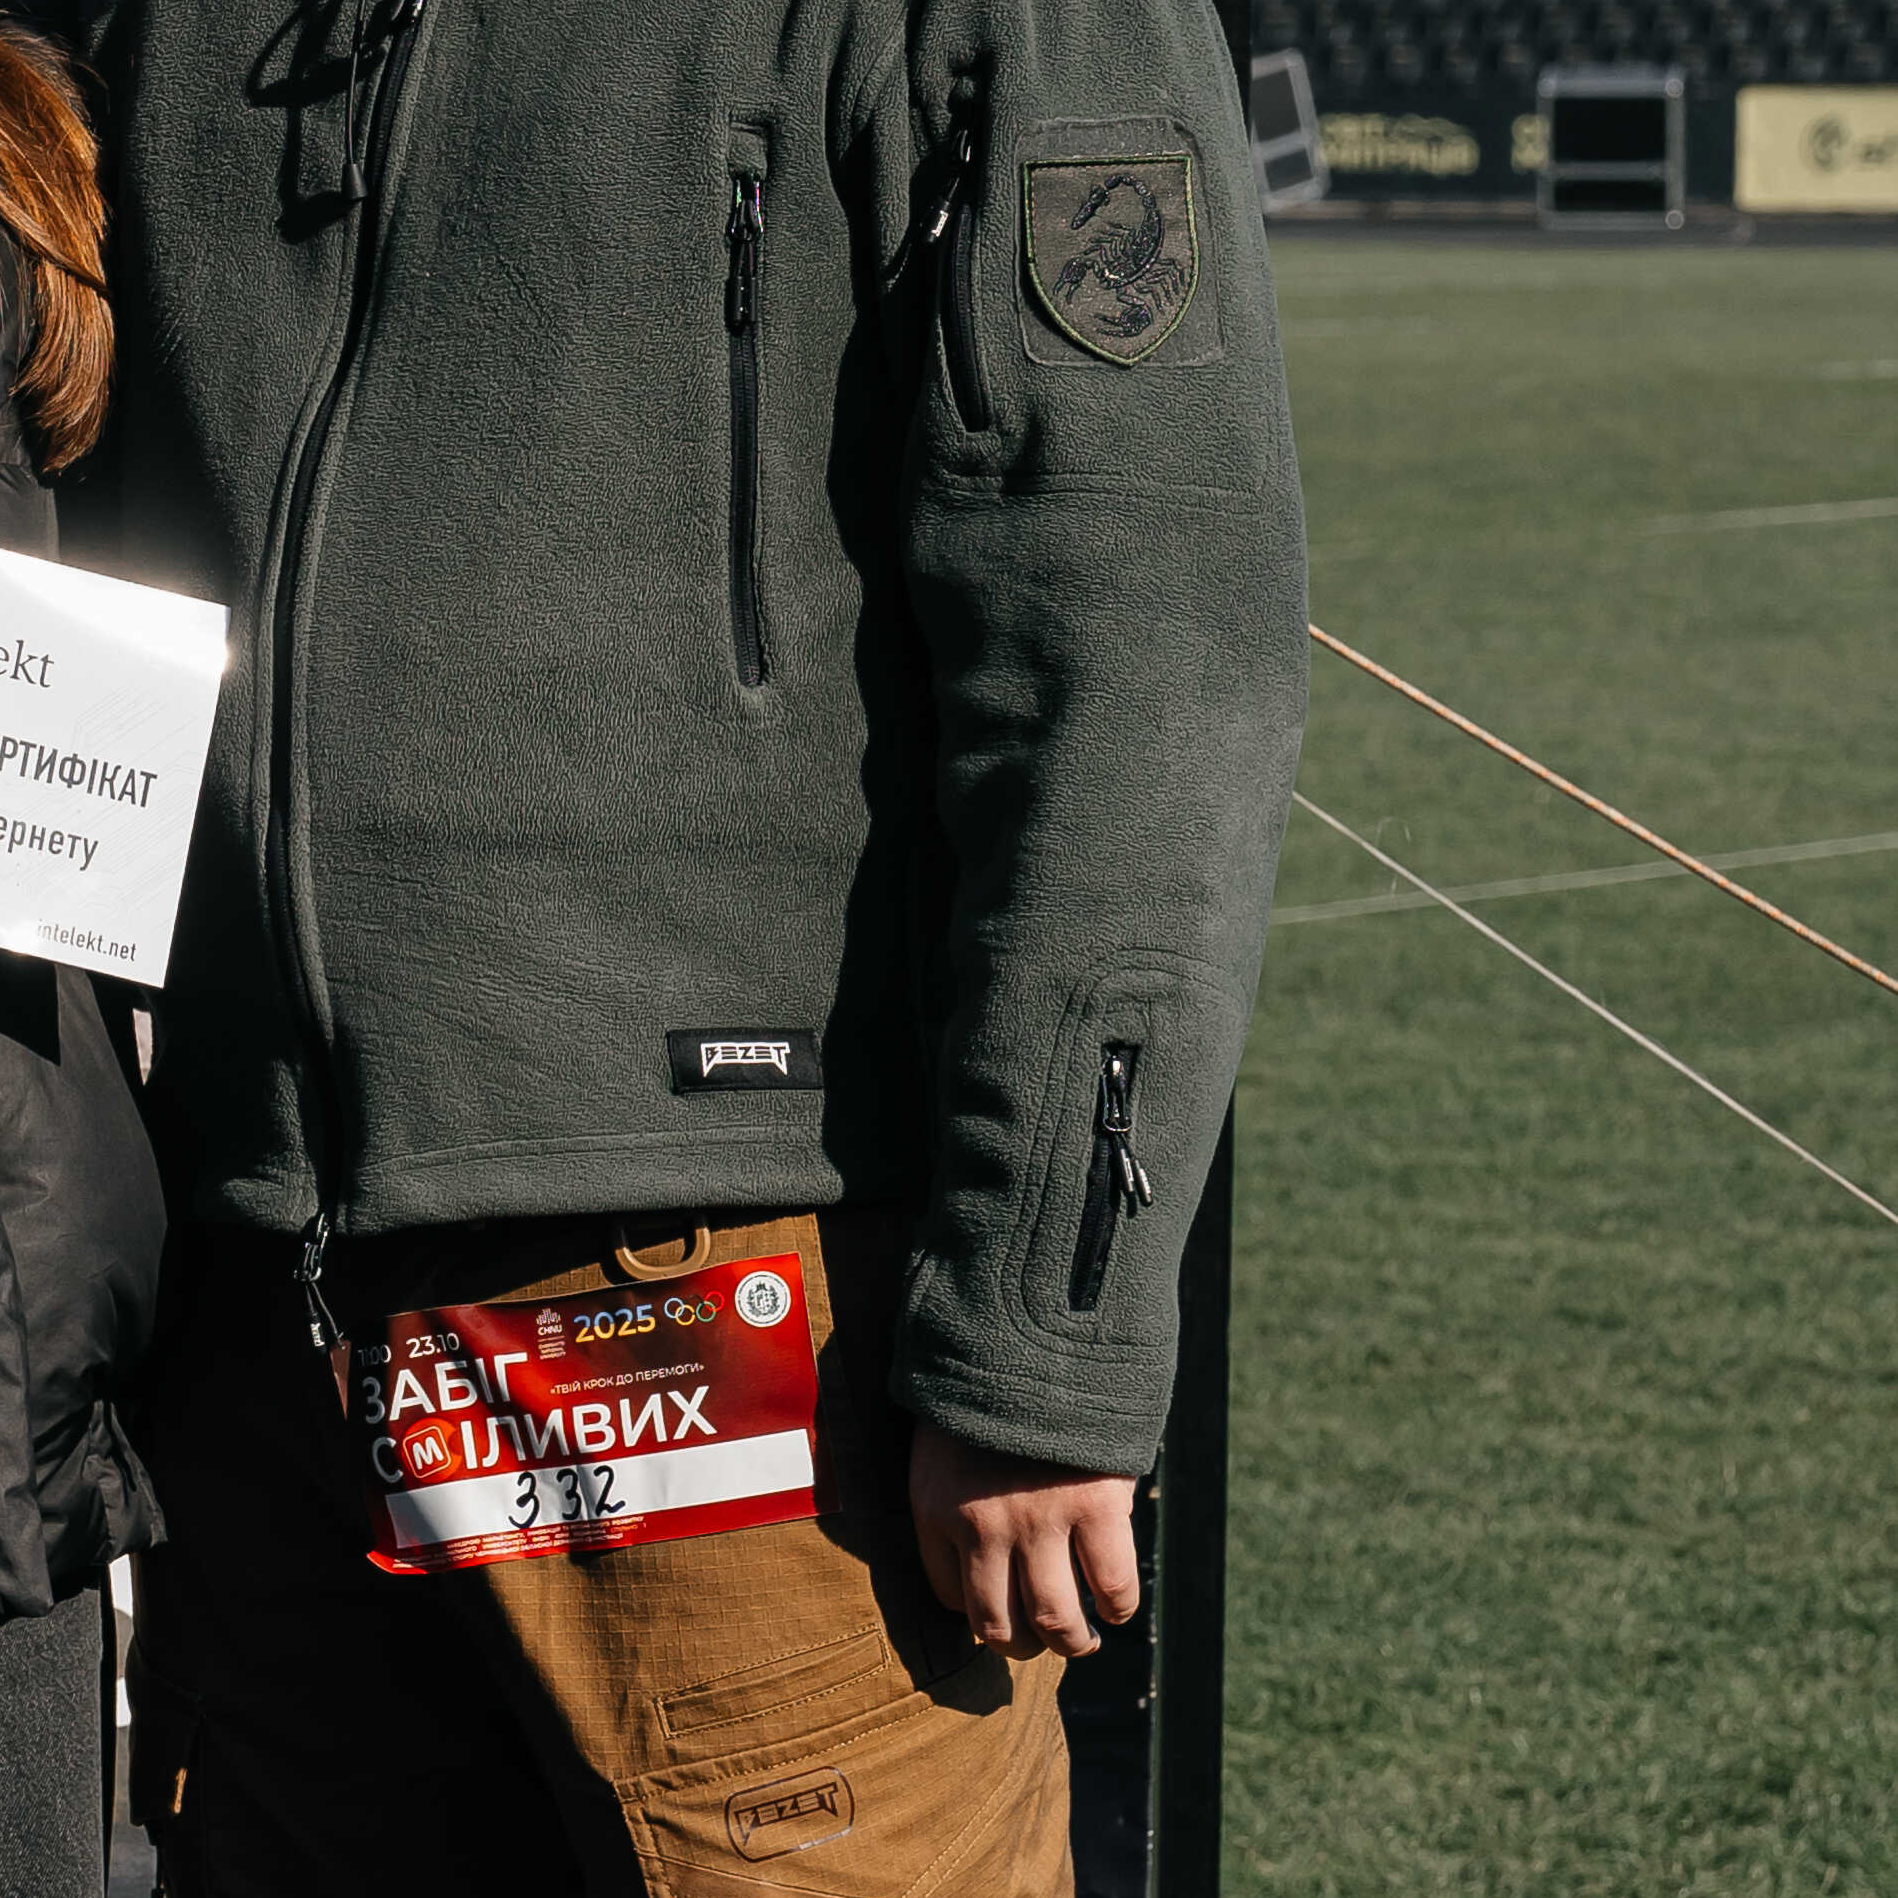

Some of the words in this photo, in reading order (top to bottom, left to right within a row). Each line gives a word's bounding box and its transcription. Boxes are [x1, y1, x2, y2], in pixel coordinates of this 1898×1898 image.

[38, 918, 137, 962] intelekt.net
[573, 1304, 656, 1343] 2025
[406, 1332, 460, 1359] 23.10
[362, 1352, 528, 1424] ЗАБІГ
[583, 1375, 615, 1390] КРОК
[616, 1372, 633, 1386] ДО
[508, 1465, 625, 1529] 332
